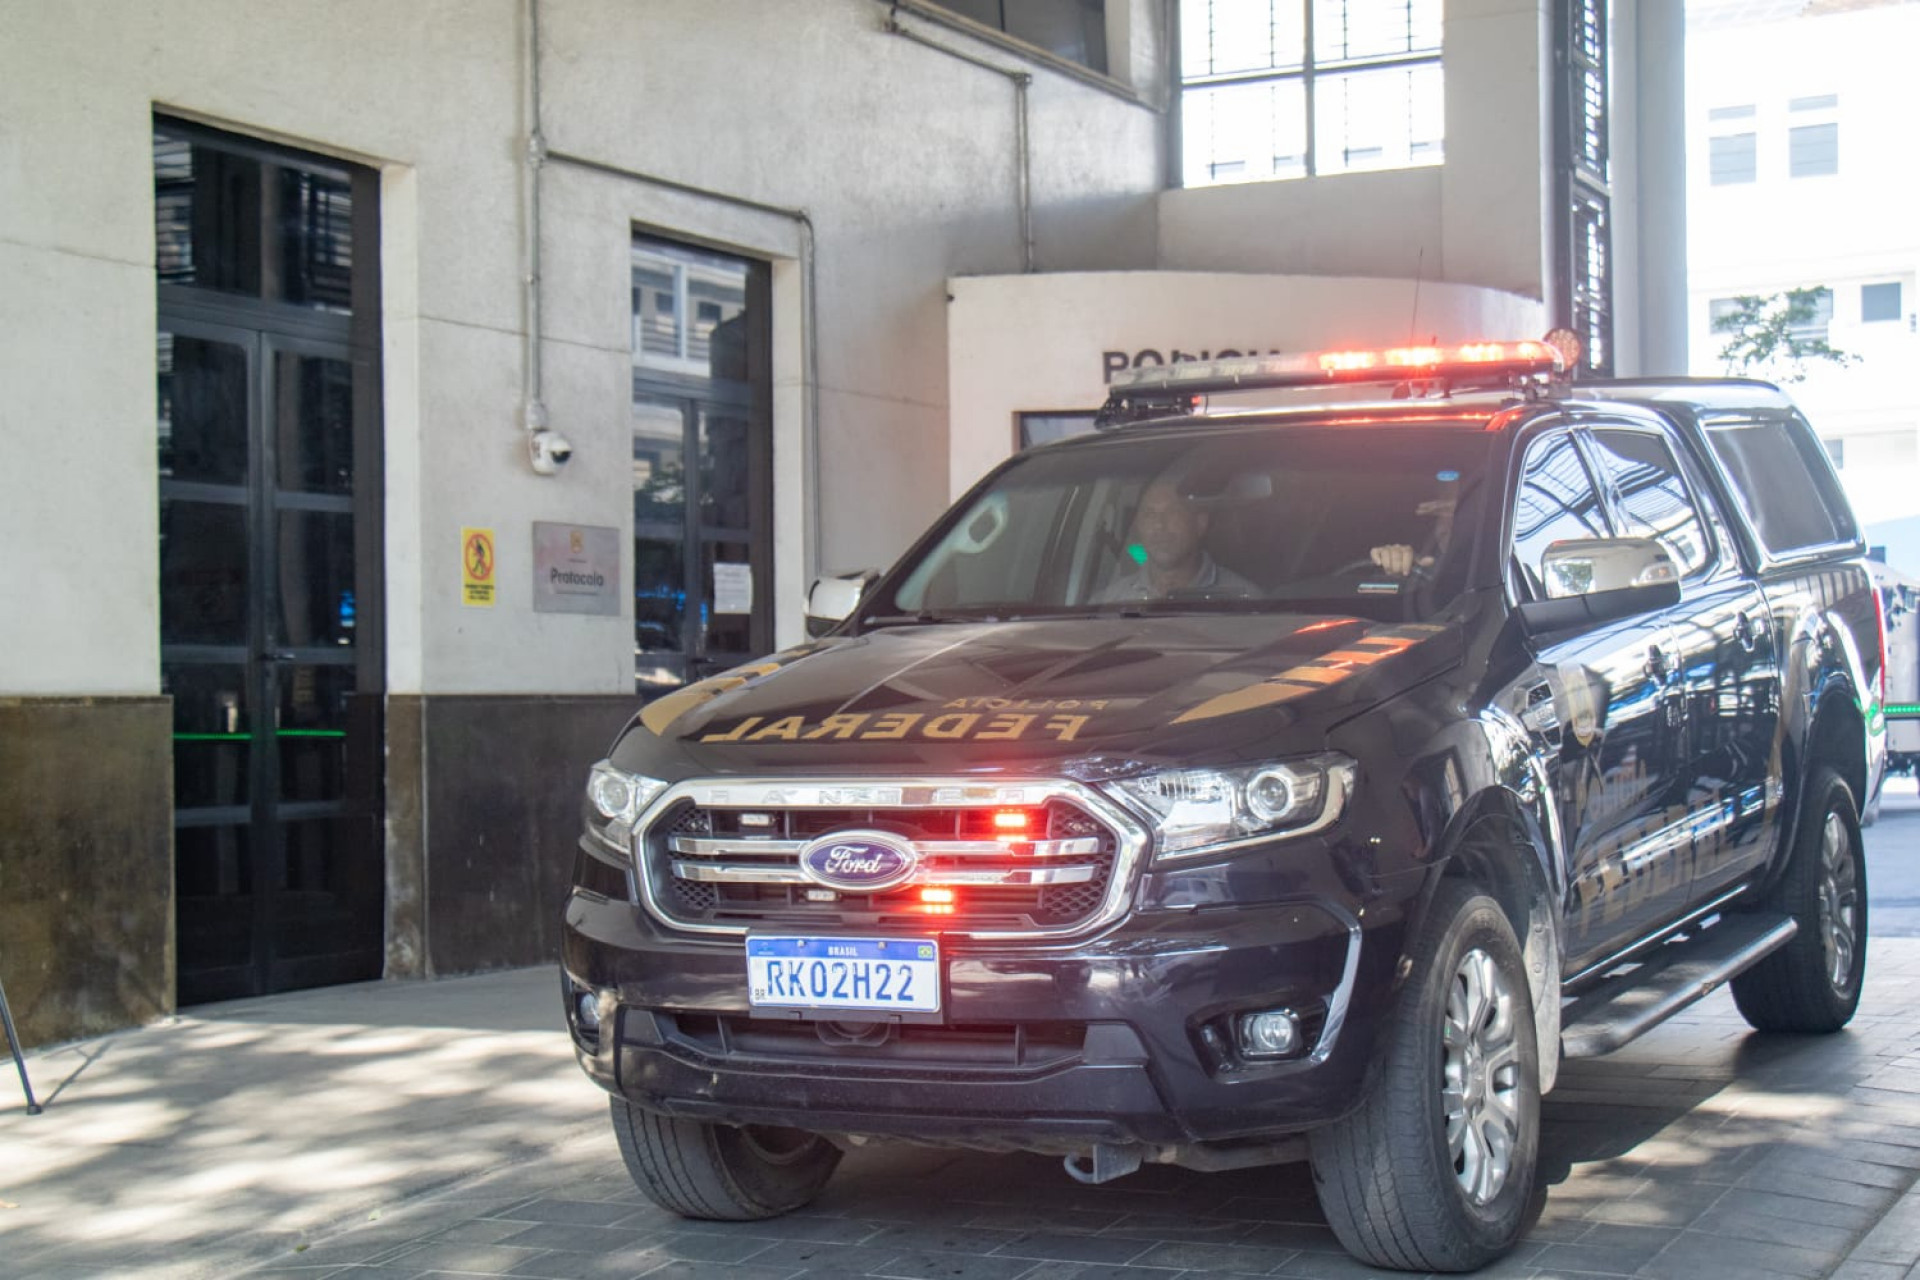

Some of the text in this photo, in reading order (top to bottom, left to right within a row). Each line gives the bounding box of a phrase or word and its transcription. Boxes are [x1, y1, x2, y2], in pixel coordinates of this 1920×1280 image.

[551, 567, 604, 586] Protocolo
[825, 845, 883, 874] Ford
[827, 945, 859, 958] BRASIL
